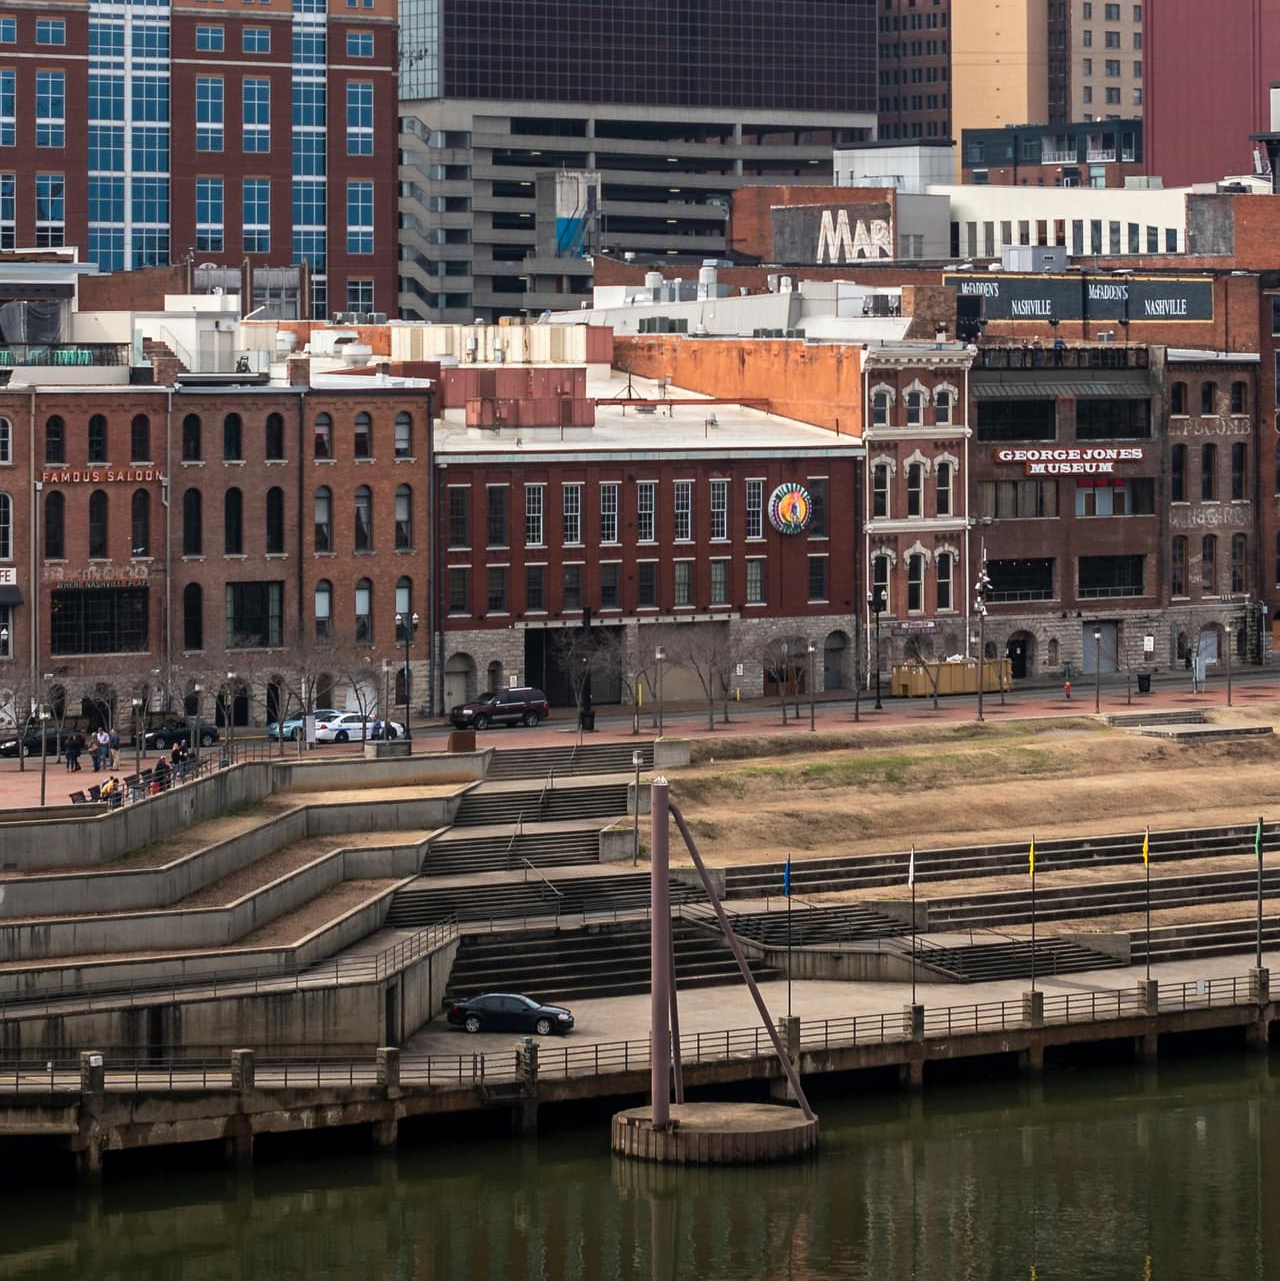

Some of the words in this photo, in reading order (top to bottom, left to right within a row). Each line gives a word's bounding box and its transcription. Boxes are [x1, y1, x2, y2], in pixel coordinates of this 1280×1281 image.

[1088, 284, 1129, 300] McFADDEN'S
[1011, 299, 1051, 316] NASHVILLE
[1144, 299, 1187, 316] NASHVILLE
[999, 450, 1081, 461] GEORGE
[1083, 449, 1143, 460] JONES
[1030, 463, 1113, 473] MUSEUM
[42, 472, 100, 483] FAMOUS
[107, 470, 163, 482] SALOON
